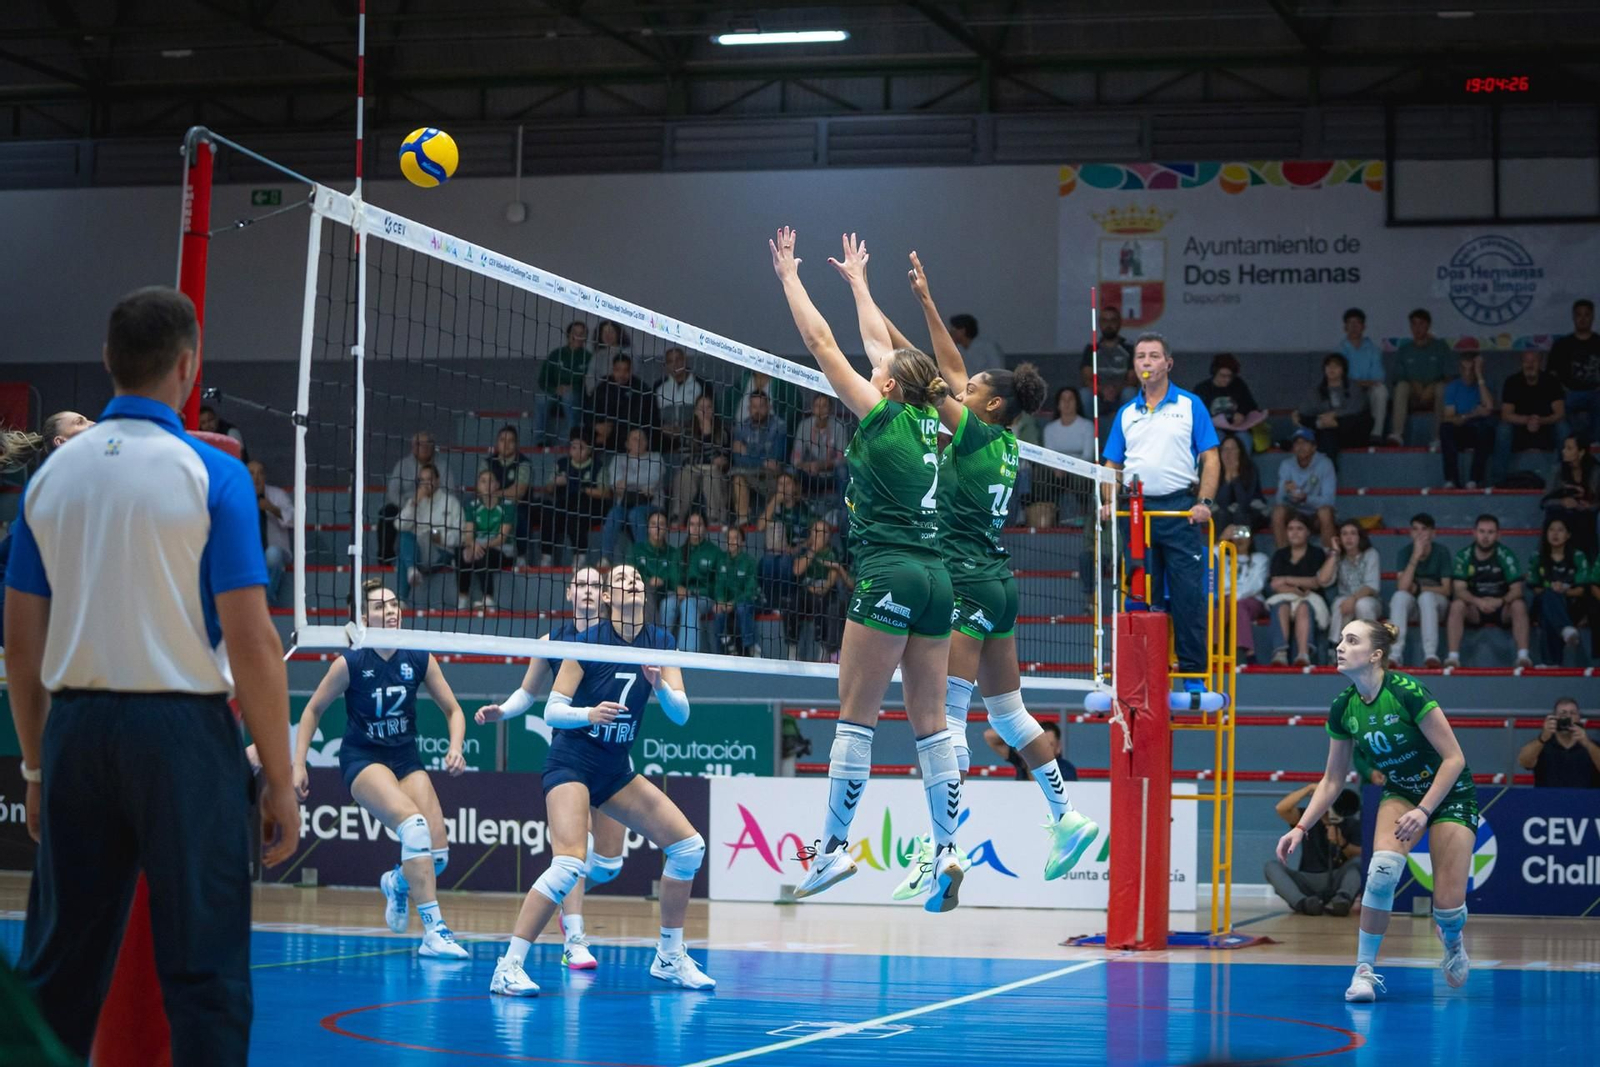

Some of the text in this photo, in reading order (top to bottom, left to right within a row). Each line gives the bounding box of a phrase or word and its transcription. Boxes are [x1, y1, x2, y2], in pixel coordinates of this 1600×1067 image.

[1465, 77, 1529, 92] 19:04:26
[393, 221, 406, 236] CEV
[1184, 234, 1361, 260] Ayuntamiento de
[1184, 264, 1361, 285] Dos Hermanas
[1437, 265, 1544, 280] Dos Hermanas
[921, 453, 938, 508] 2
[853, 598, 861, 612] 2
[400, 663, 413, 680] SB
[371, 685, 407, 718] 12
[615, 672, 637, 712] 7
[643, 738, 756, 762] Diputación
[1364, 731, 1392, 755] 10
[1374, 750, 1418, 768] undación
[1522, 816, 1589, 845] CEV
